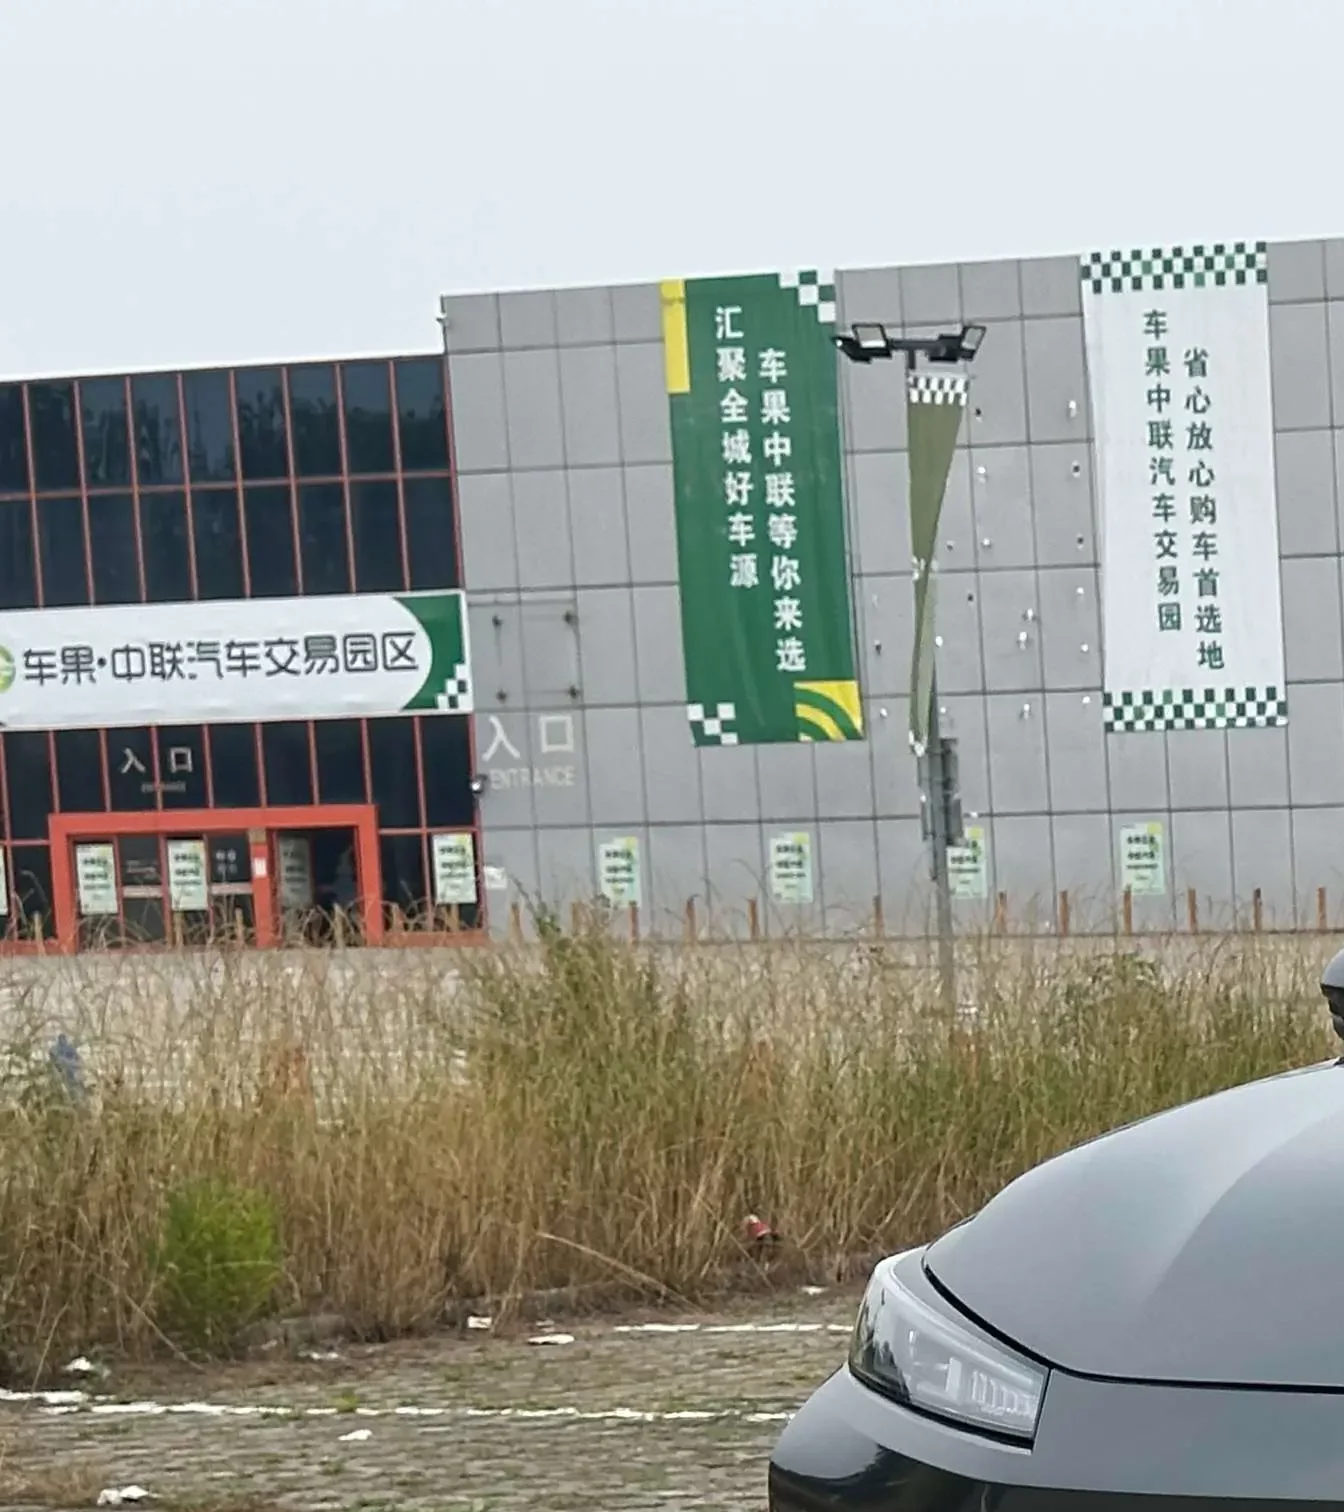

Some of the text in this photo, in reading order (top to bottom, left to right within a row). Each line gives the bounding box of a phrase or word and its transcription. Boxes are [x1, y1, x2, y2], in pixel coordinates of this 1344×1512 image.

[715, 305, 758, 588] 汇聚全城好车源
[758, 348, 806, 672] 车果中联等你来选
[1143, 310, 1182, 632] 车果中联汽车交易园
[1184, 347, 1225, 671] 省心放心购车首选地
[120, 747, 193, 774] 入口
[481, 715, 575, 762] 入口
